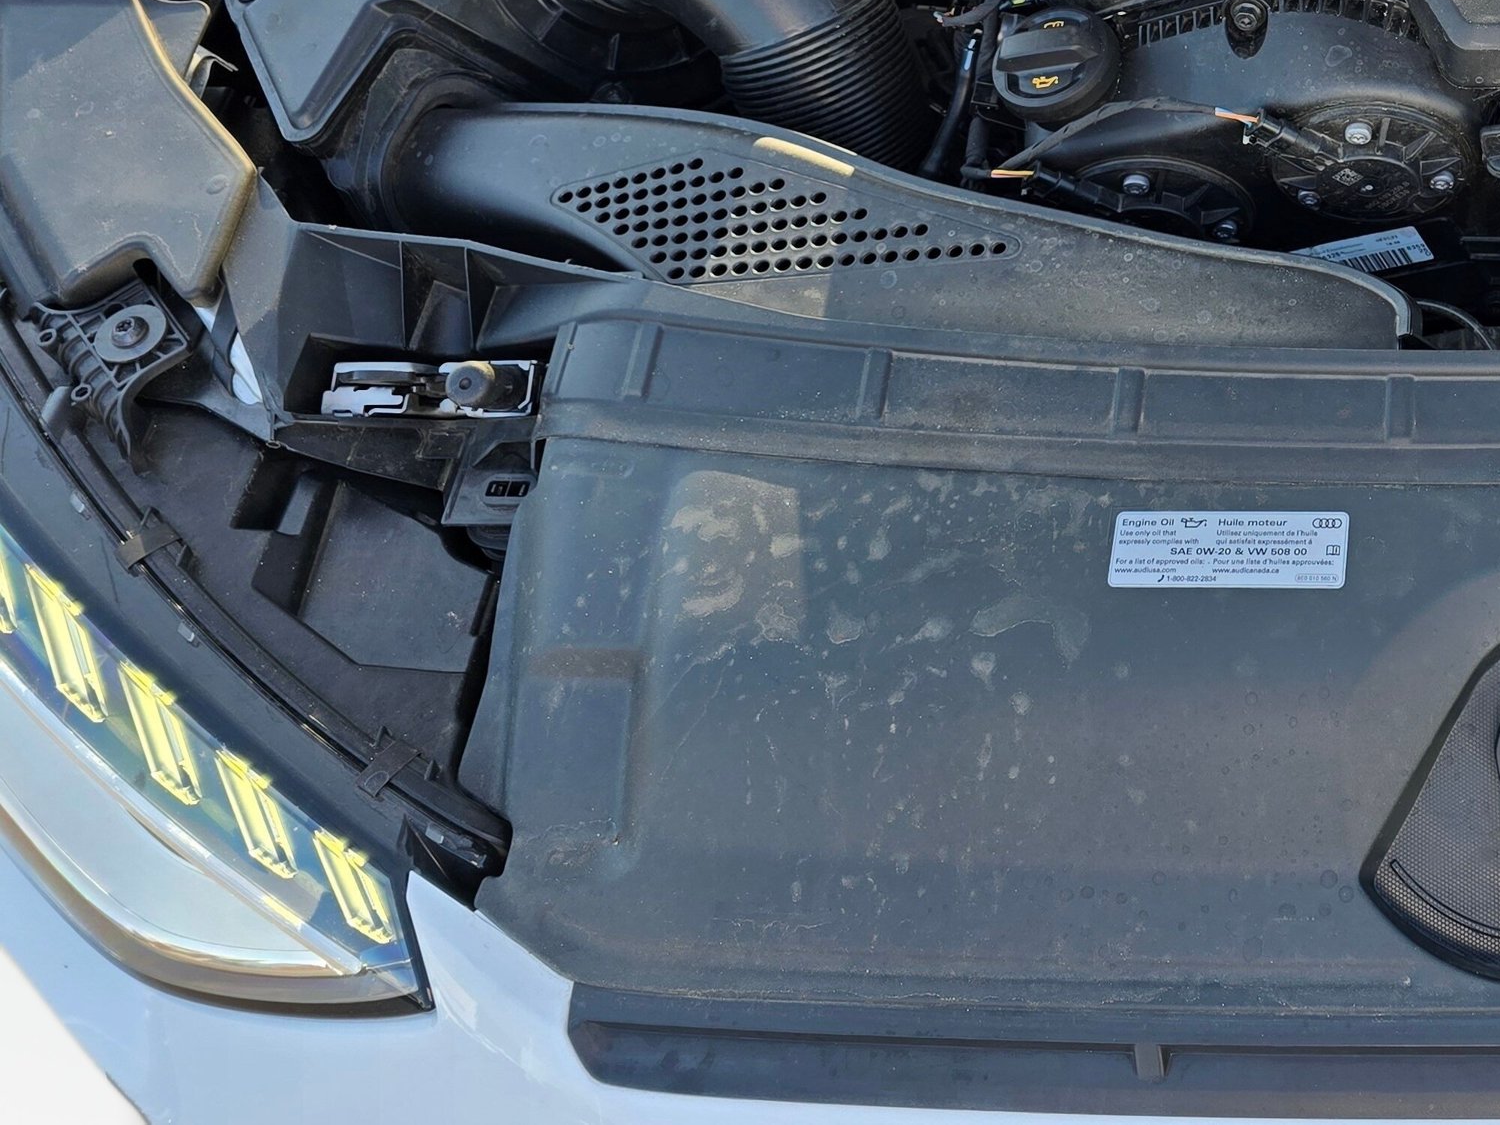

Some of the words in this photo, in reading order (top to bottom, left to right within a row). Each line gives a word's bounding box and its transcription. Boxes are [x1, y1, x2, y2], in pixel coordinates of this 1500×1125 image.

[1122, 518, 1157, 527] Engine
[1160, 518, 1175, 526] Oil
[1218, 518, 1245, 526] Huile
[1271, 548, 1291, 556] 508
[1294, 548, 1308, 556] 00
[1155, 558, 1189, 566] approved
